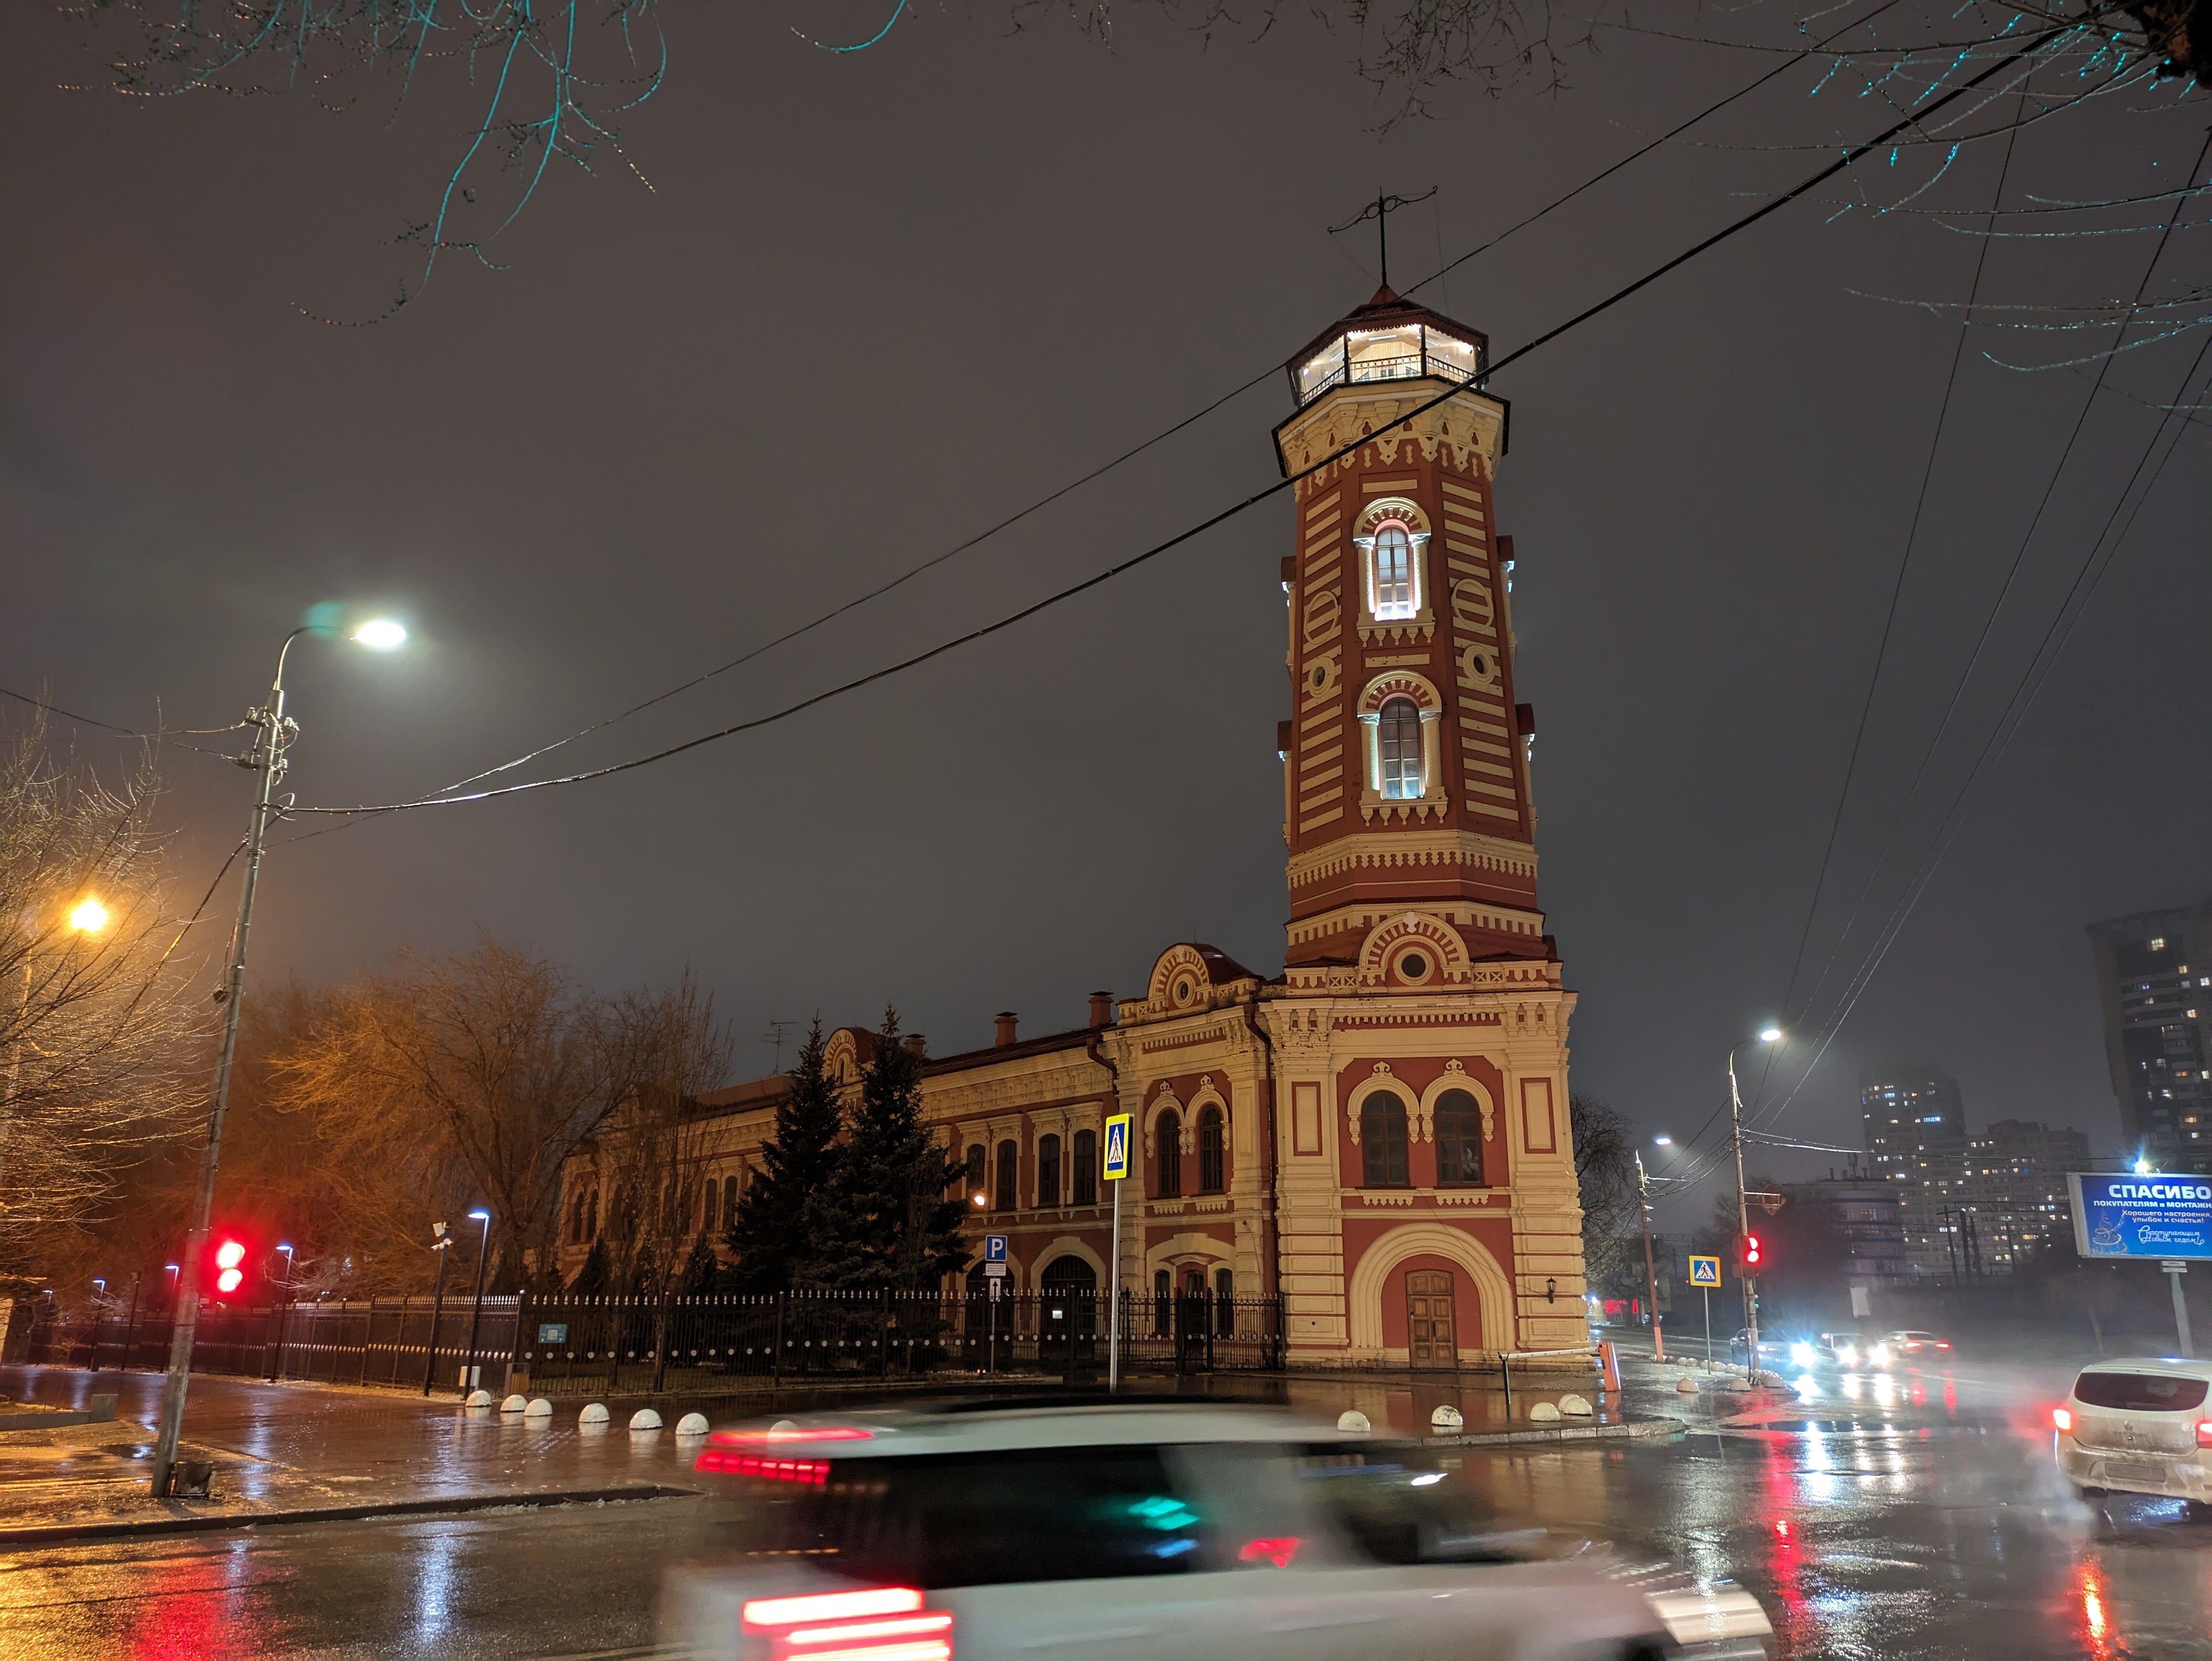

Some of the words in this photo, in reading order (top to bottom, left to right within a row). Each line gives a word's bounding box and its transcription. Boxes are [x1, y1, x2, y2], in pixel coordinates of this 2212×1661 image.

[2109, 1185, 2211, 1199] СПАСИБО
[2141, 1233, 2172, 1244] Новым
[2174, 1235, 2204, 1246] годом!
[992, 1238, 1003, 1258] P
